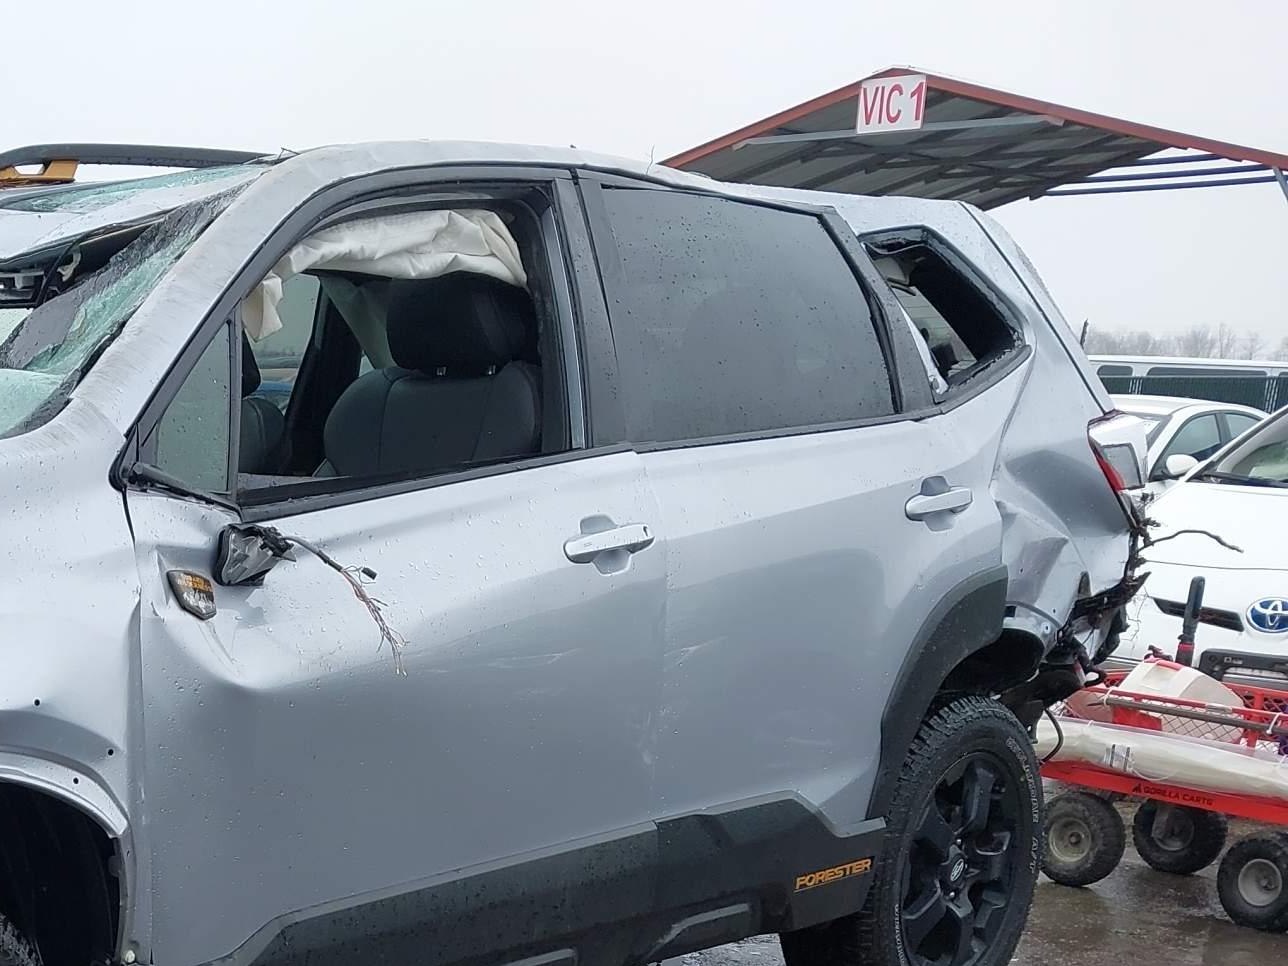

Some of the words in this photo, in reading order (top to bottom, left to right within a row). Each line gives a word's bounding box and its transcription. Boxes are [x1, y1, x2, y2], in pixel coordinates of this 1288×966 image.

[862, 83, 904, 126] VIC
[910, 81, 926, 121] 1
[795, 858, 872, 891] FORESTER
